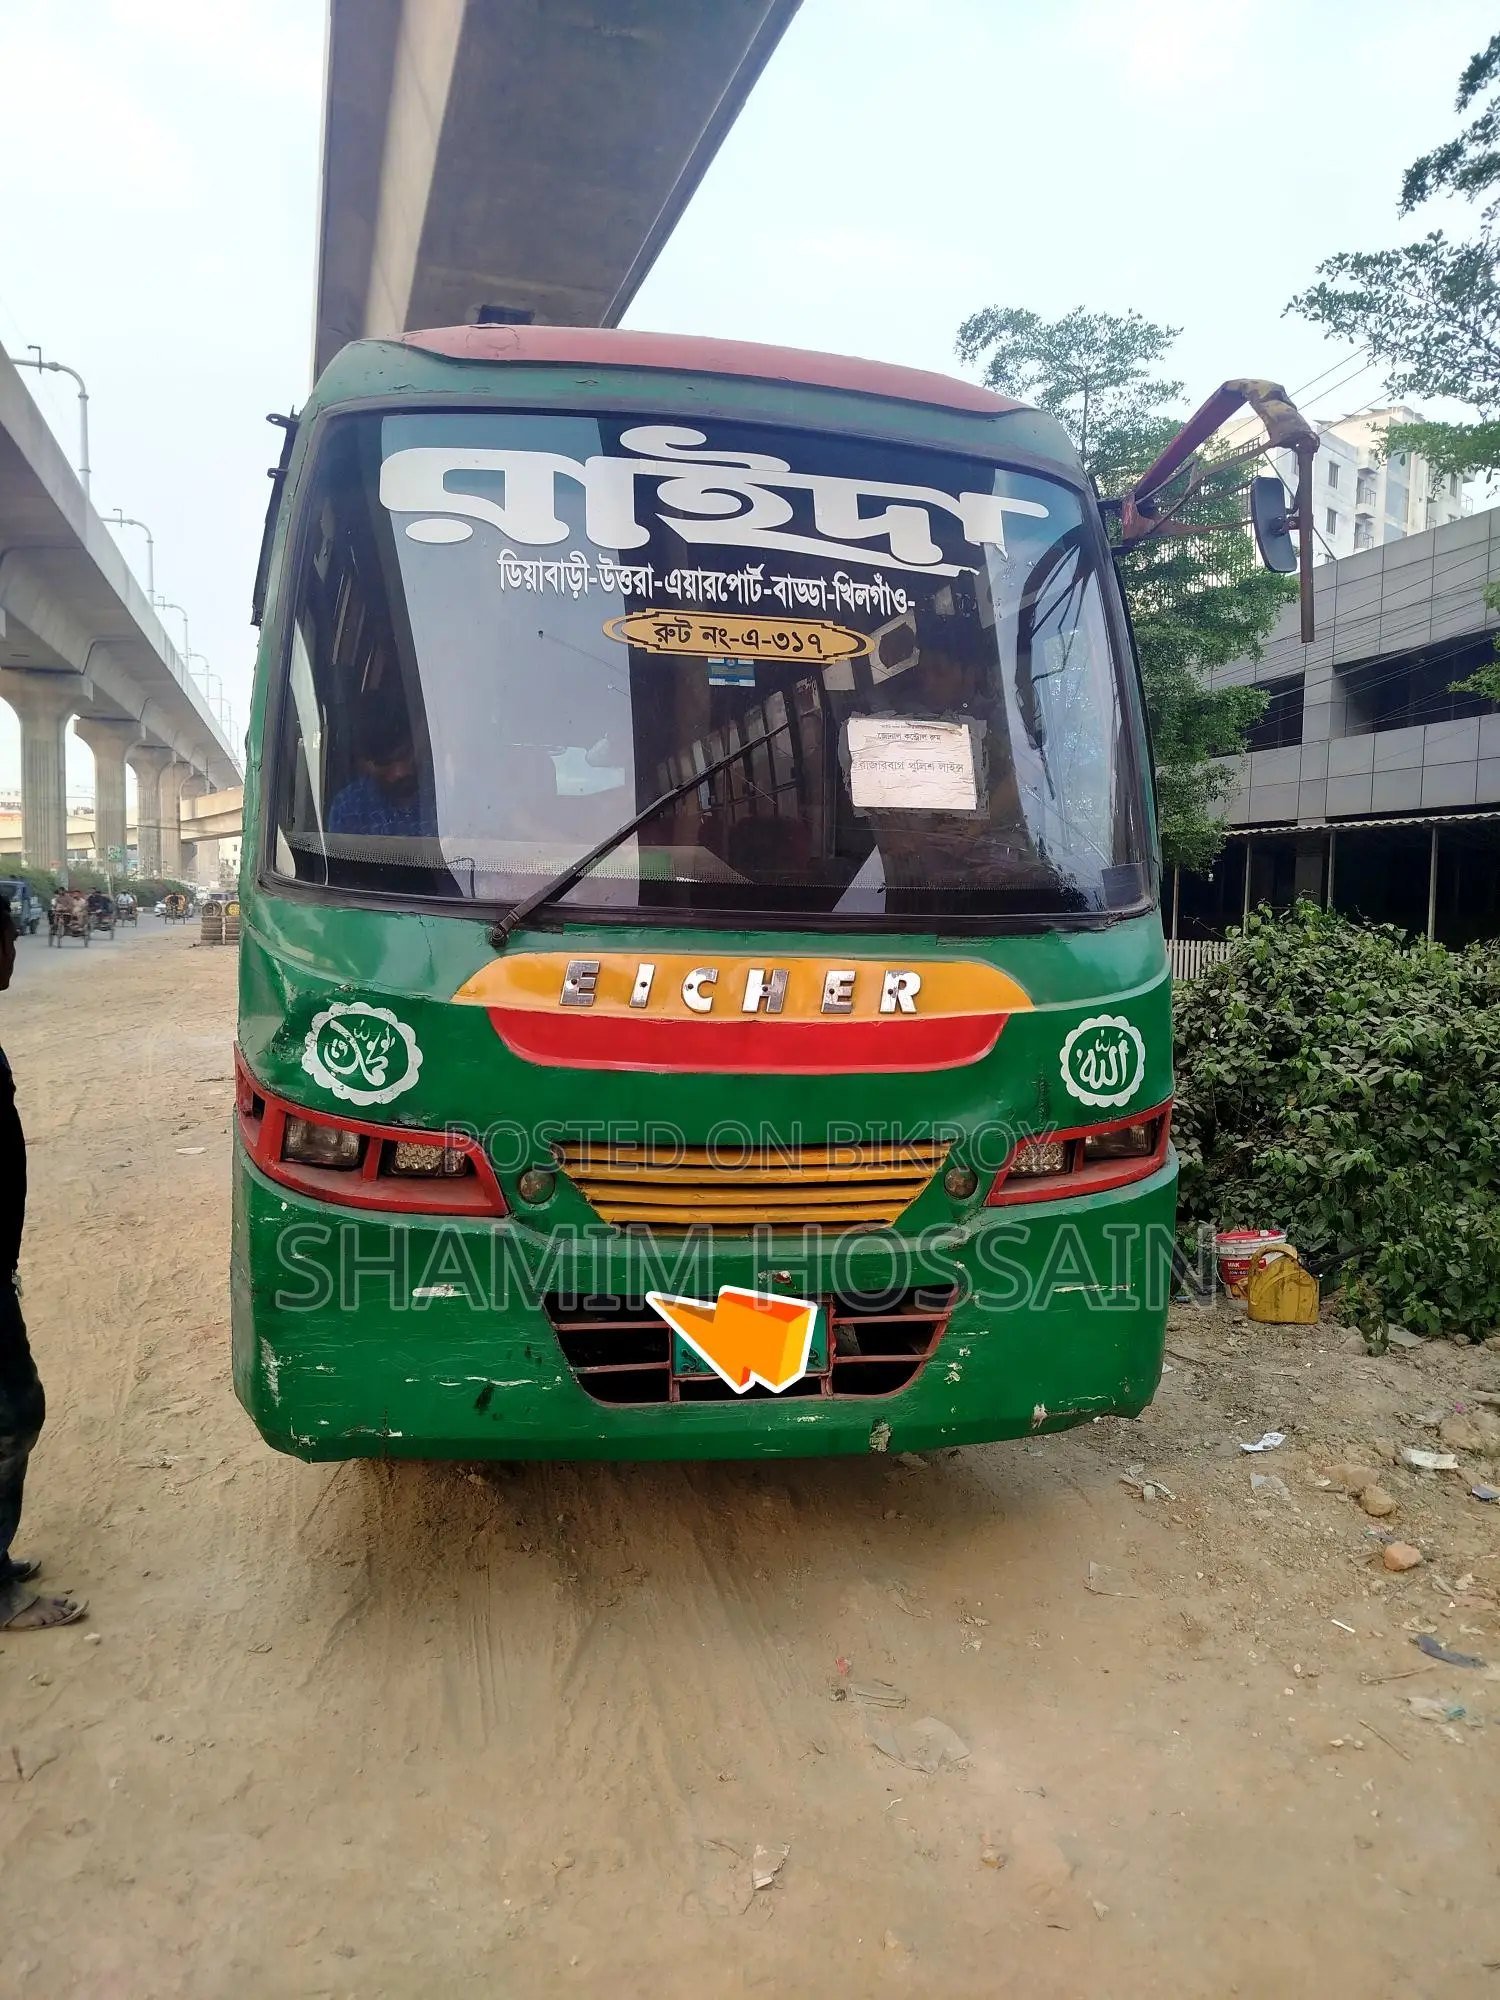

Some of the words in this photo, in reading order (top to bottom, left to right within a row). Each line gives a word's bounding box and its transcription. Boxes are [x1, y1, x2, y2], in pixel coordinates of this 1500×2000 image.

[379, 425, 1050, 577] রাইদা
[652, 616, 692, 645] রুট
[559, 960, 921, 1014] EICHER
[1076, 1029, 1130, 1090] الله
